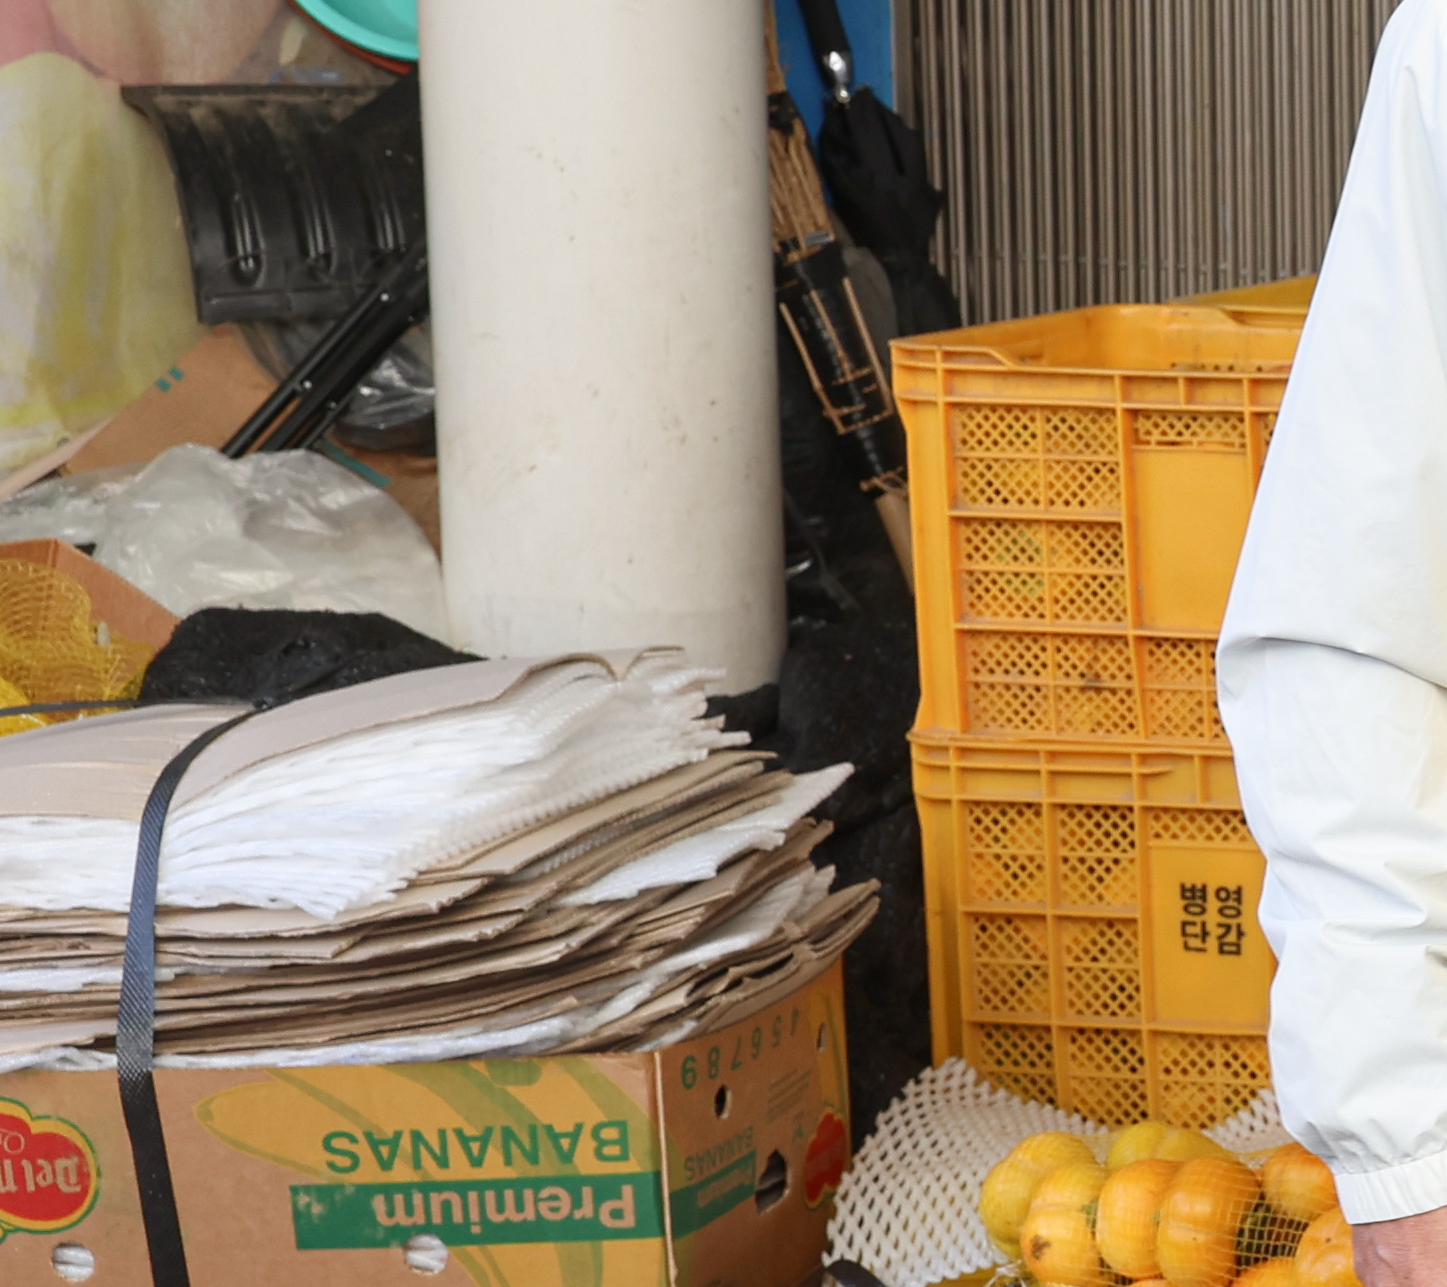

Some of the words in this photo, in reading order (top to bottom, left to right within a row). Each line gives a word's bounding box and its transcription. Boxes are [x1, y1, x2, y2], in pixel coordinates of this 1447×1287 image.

[1180, 882, 1242, 919] 병영
[1181, 921, 1246, 955] 단감
[324, 1121, 631, 1174] BANANAS
[376, 1185, 637, 1229] Premium
